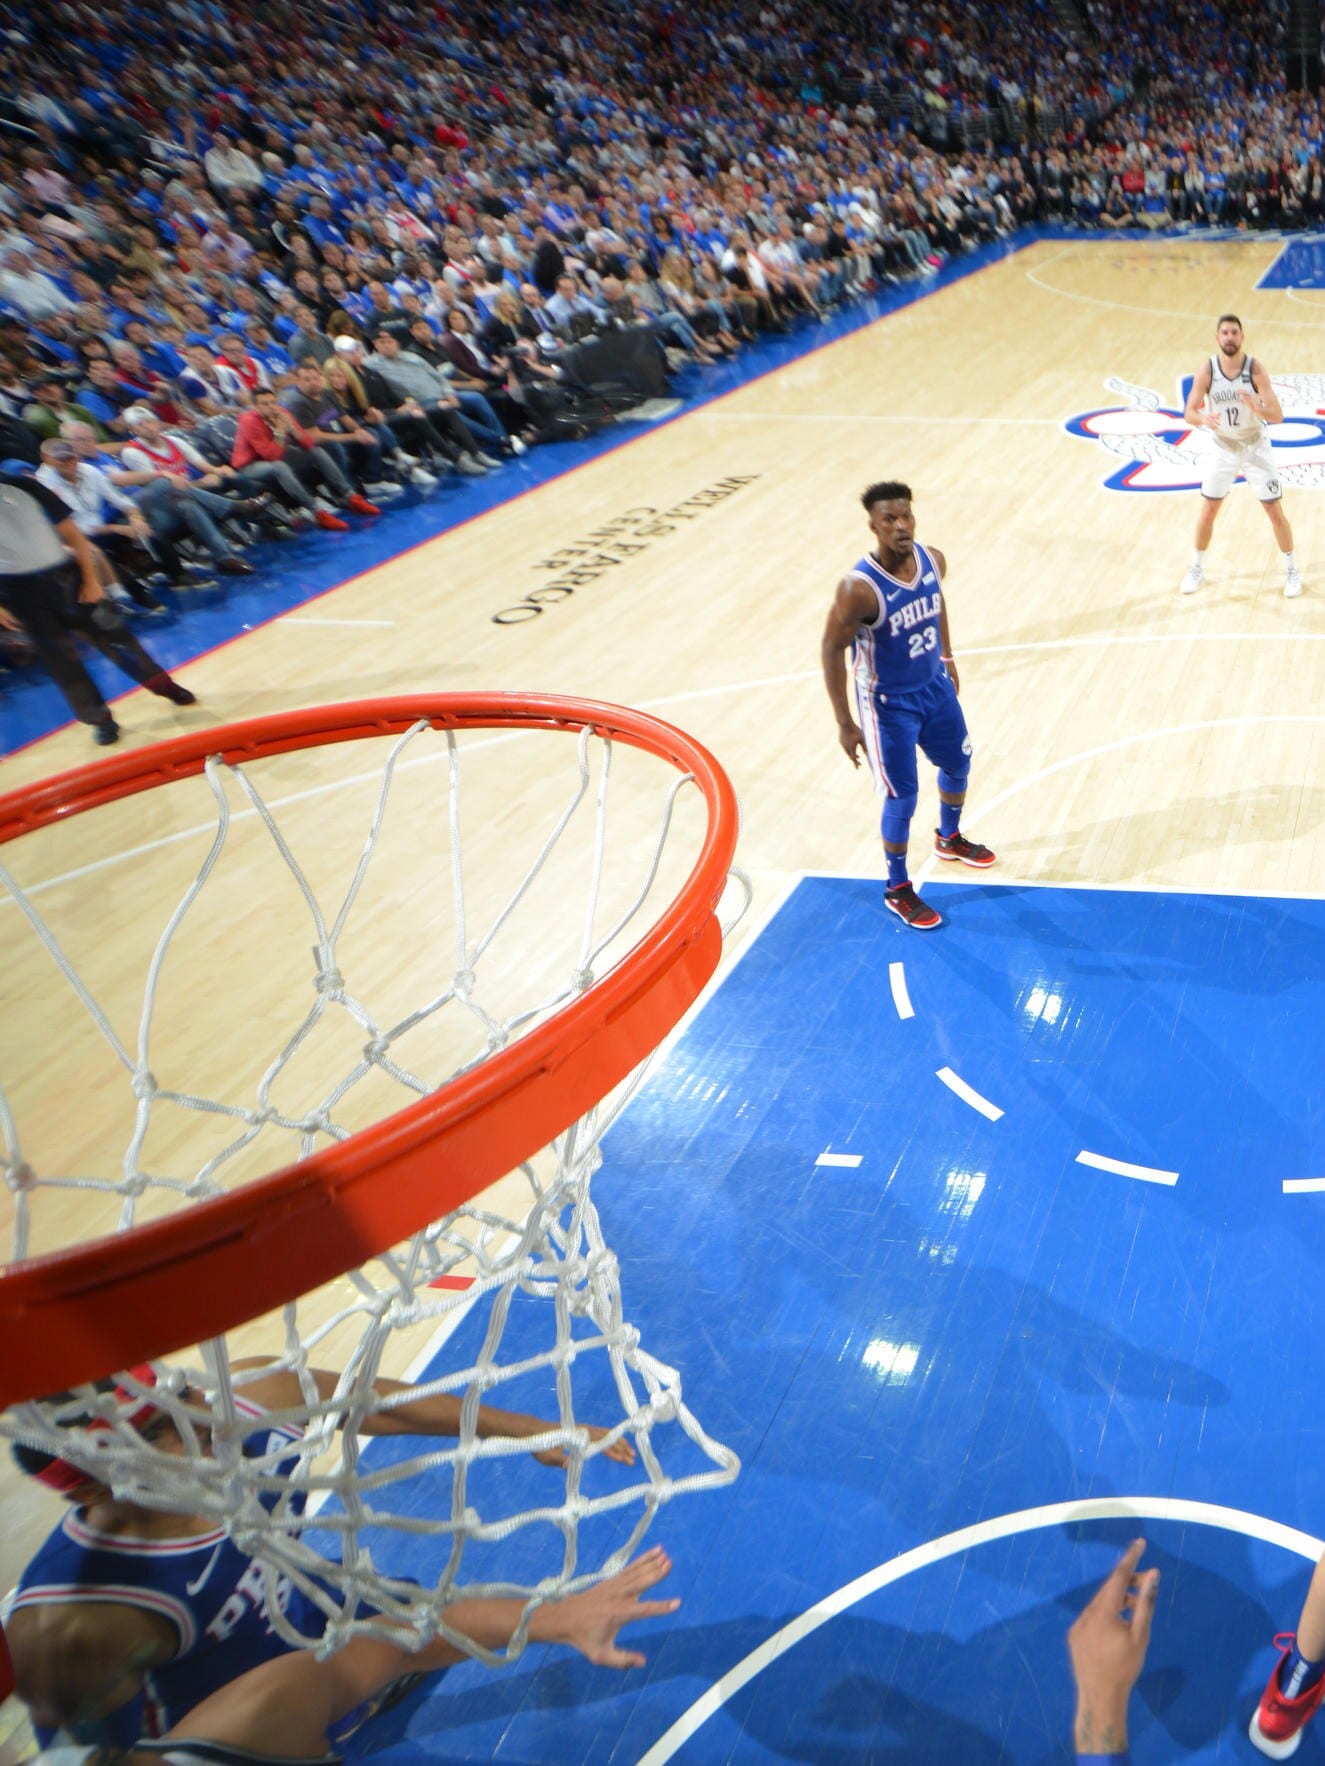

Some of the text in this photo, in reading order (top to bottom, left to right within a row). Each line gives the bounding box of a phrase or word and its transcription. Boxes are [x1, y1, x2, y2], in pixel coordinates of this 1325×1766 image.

[1212, 389, 1241, 404] BROOK
[1226, 407, 1240, 427] 12
[491, 473, 763, 625] WELLS FARGO
[530, 506, 657, 570] CENTER
[888, 592, 942, 637] PHILA
[908, 625, 937, 659] 23
